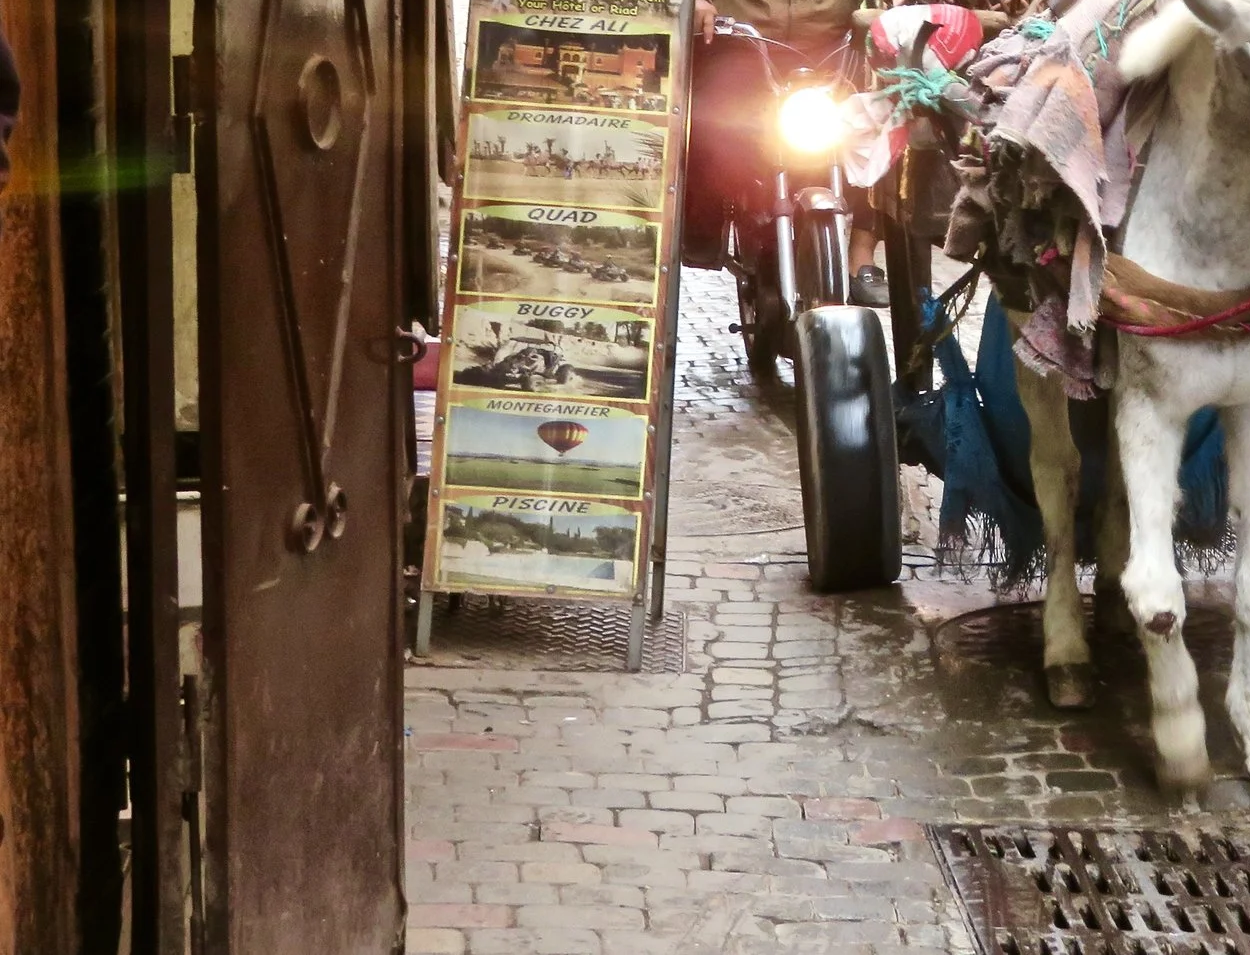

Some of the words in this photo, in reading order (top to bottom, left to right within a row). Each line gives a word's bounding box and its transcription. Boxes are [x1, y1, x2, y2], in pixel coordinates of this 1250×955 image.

[591, 5, 605, 13] or
[610, 5, 638, 17] Riad
[524, 14, 584, 30] CHEZ
[590, 19, 629, 33] ALI
[508, 112, 631, 129] DROMADAIRE
[527, 208, 598, 224] QUAD
[516, 303, 595, 320] BUGGY
[486, 399, 611, 418] MONTEGANFIER
[491, 496, 593, 514] PISCINE
